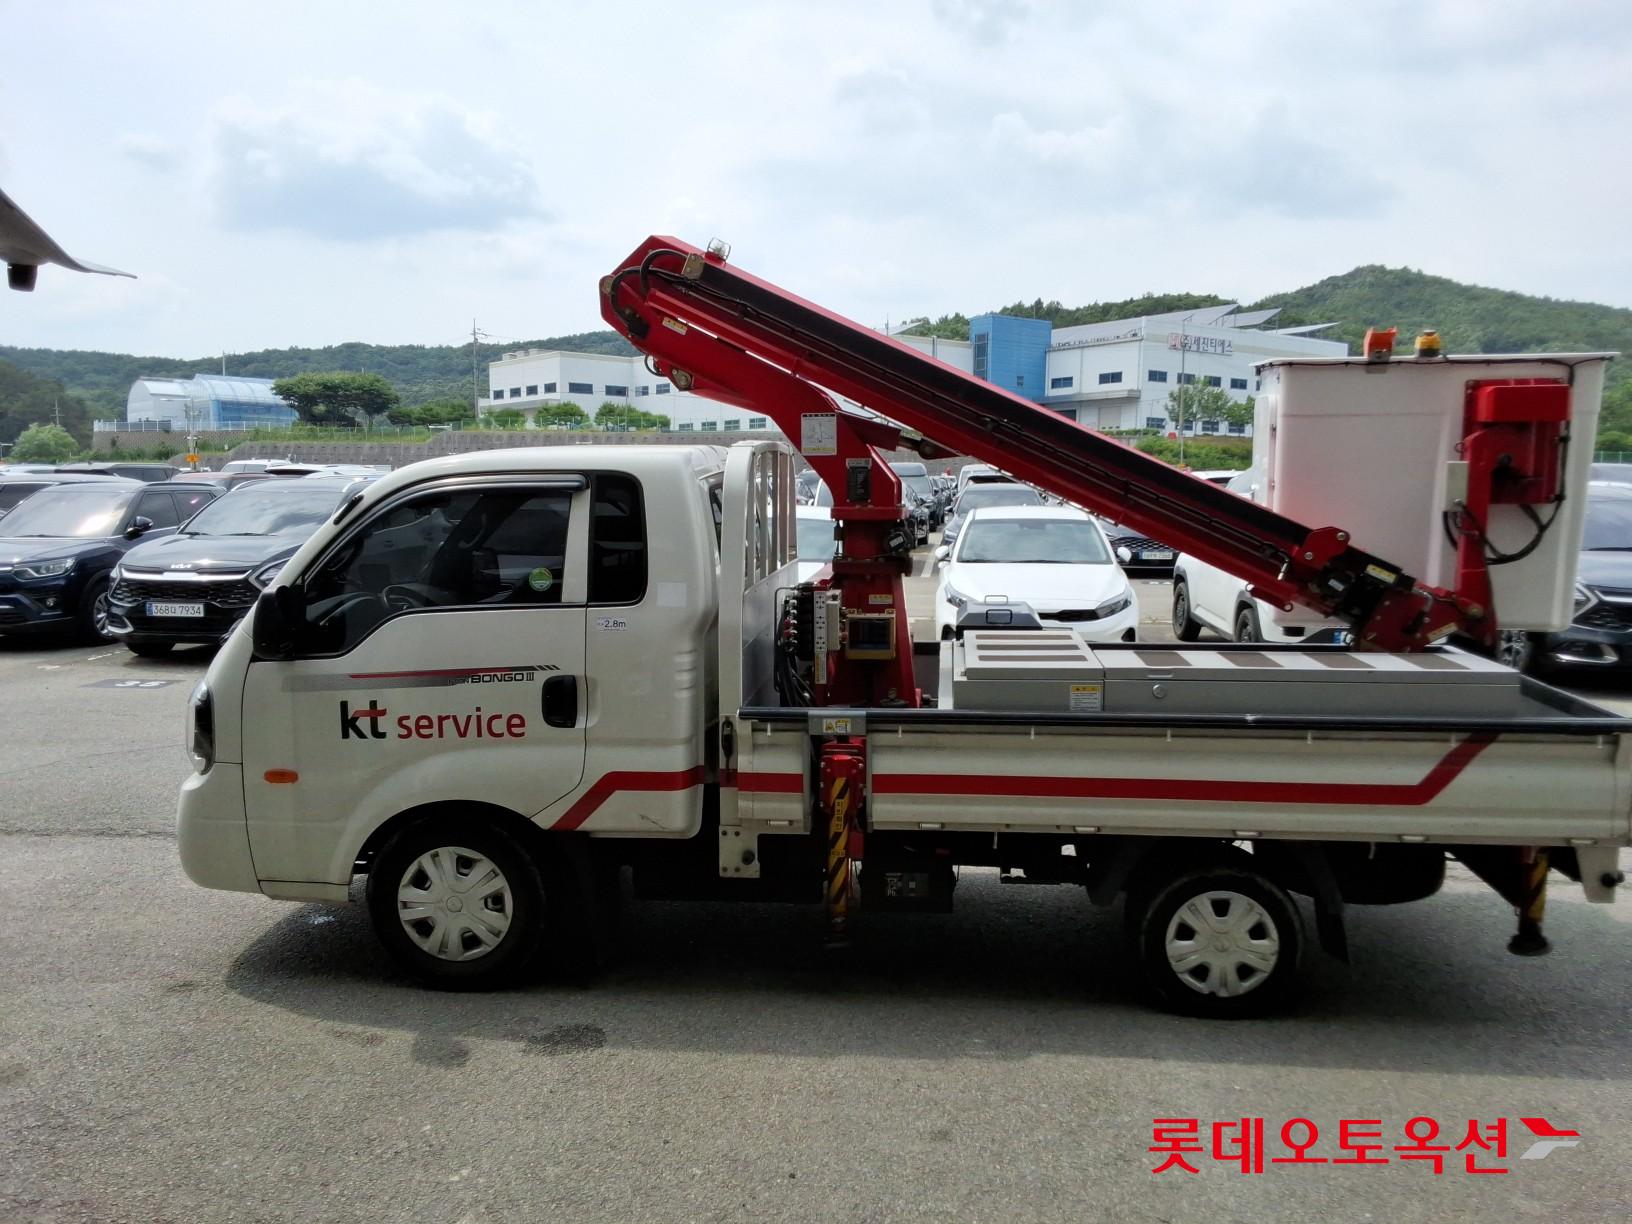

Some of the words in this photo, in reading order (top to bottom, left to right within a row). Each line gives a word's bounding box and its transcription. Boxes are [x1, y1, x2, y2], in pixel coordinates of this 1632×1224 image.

[179, 605, 201, 616] 7934
[471, 672, 524, 684] BONGO
[340, 700, 387, 740] kt
[397, 706, 526, 740] service
